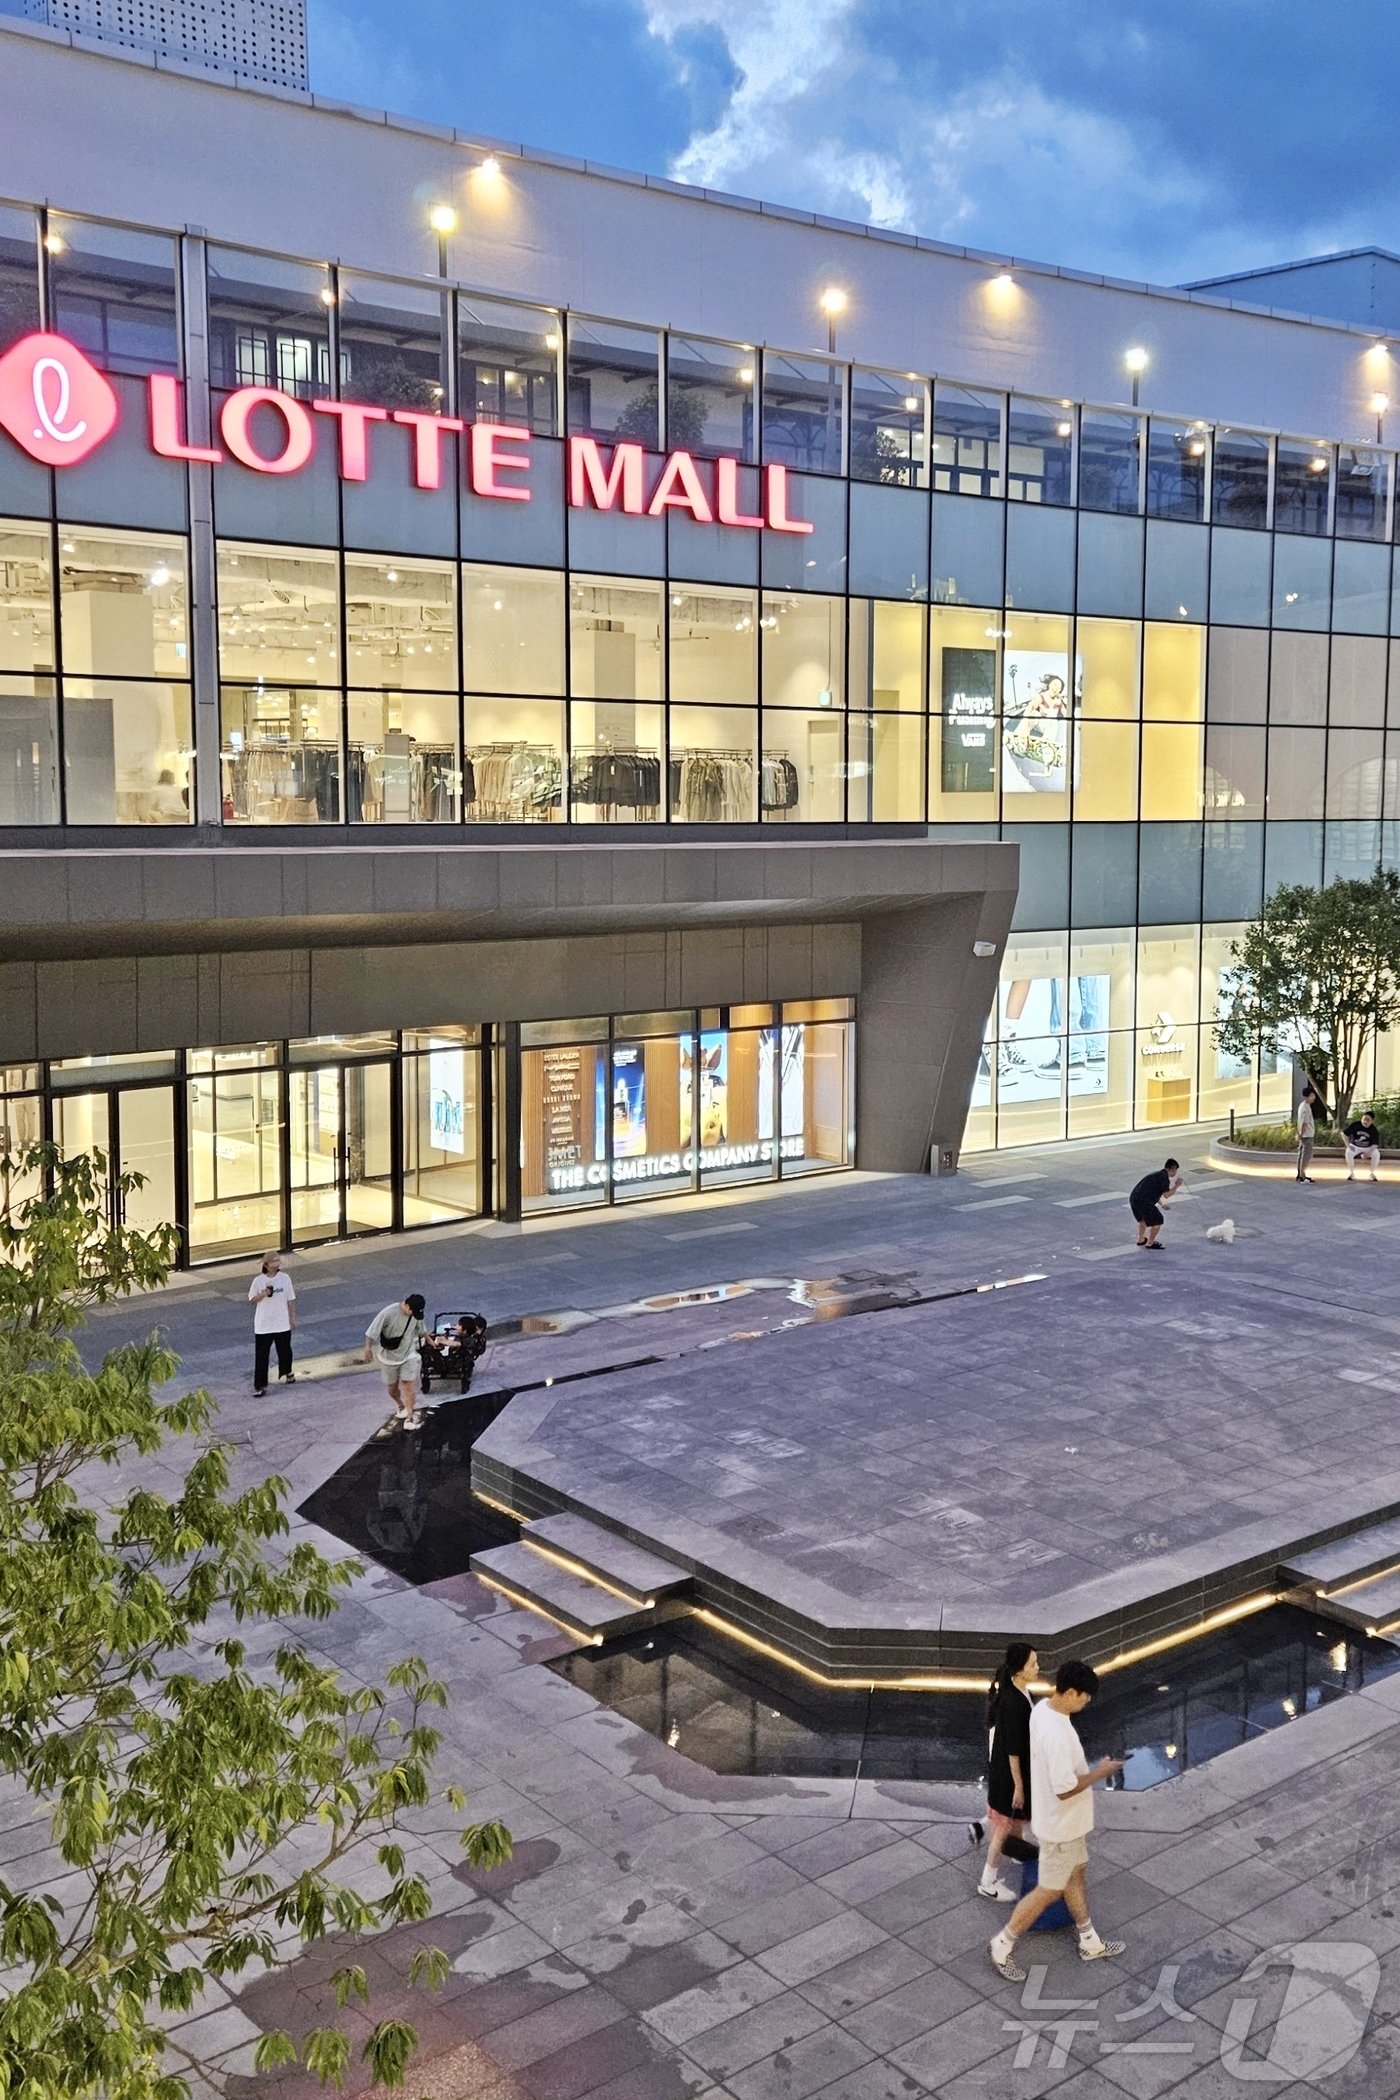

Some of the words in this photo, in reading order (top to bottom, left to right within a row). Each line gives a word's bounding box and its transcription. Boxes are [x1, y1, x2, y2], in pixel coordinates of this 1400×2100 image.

[147, 373, 532, 501] LOTTE
[569, 435, 815, 534] MALL
[952, 693, 994, 715] Always
[551, 1167, 584, 1189] THE
